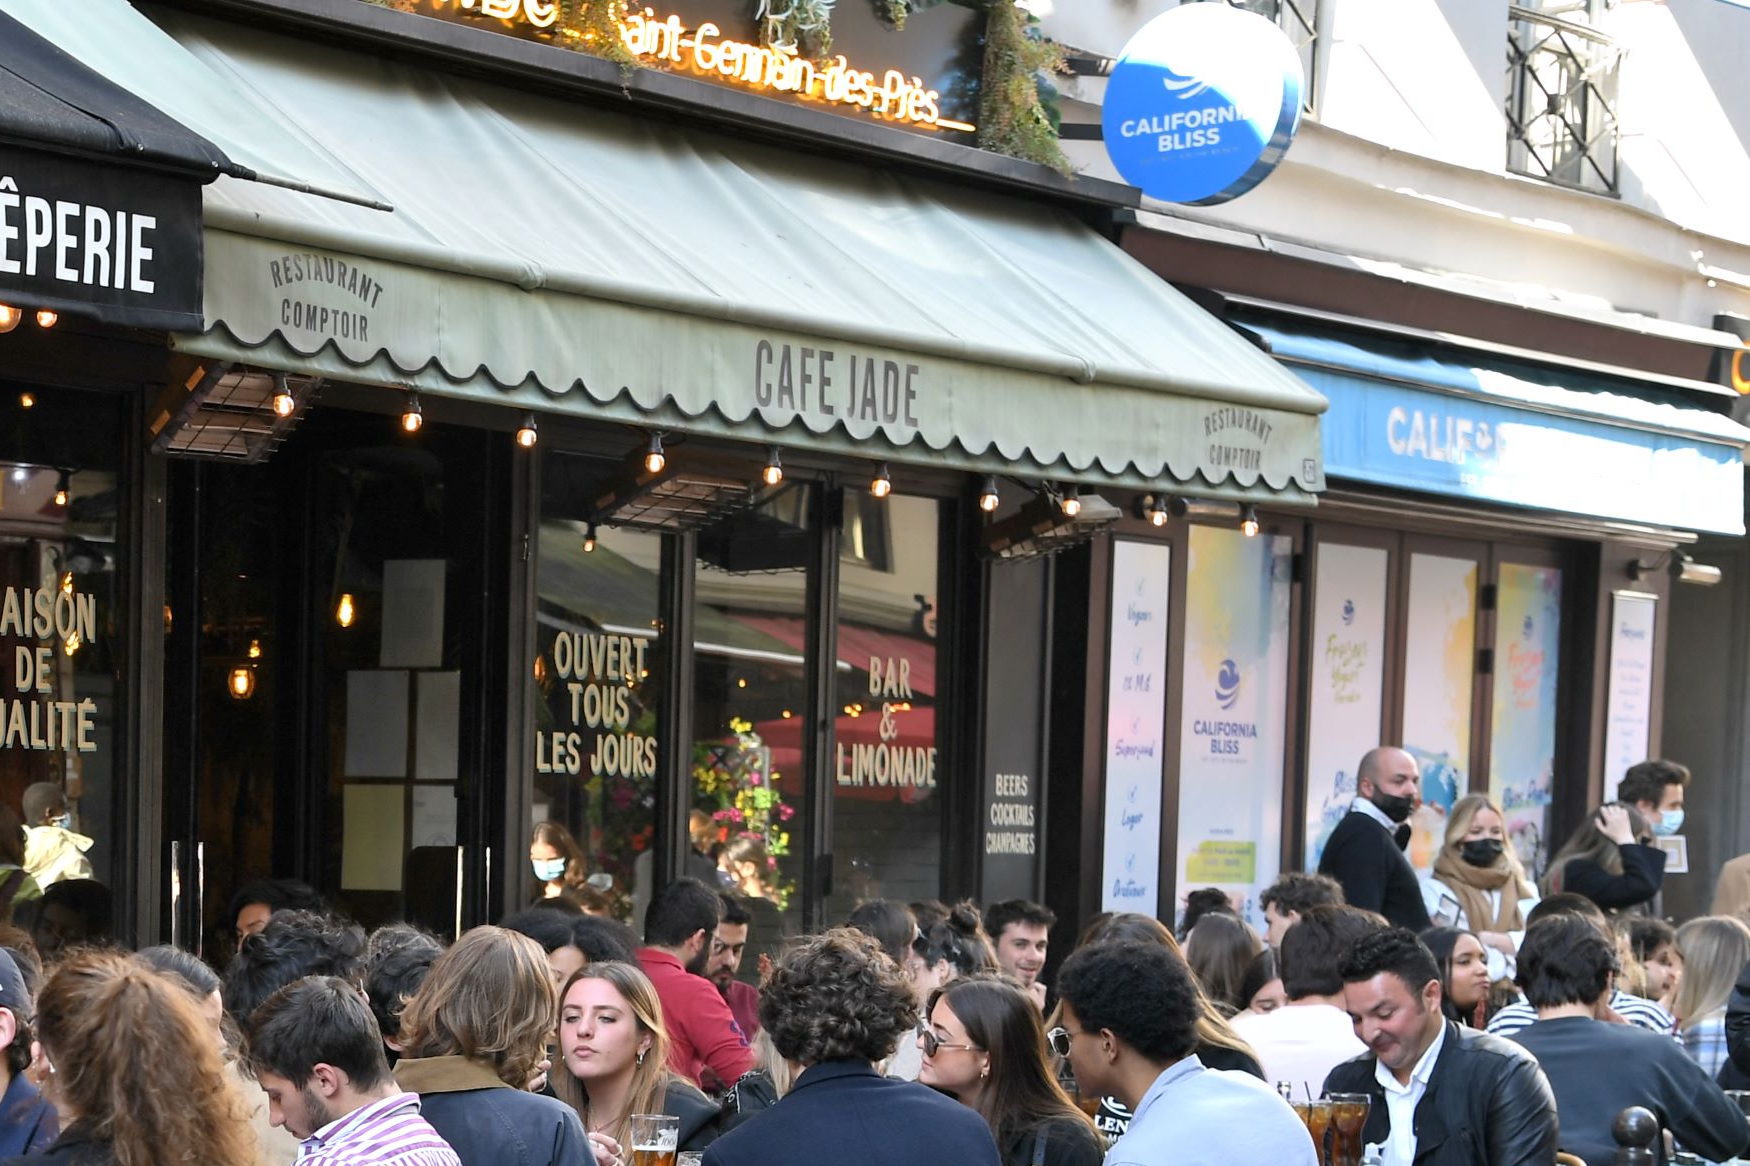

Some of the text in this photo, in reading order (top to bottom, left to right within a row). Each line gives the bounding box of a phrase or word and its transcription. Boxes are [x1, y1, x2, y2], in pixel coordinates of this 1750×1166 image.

[1120, 105, 1252, 138] CALIFORNI
[1158, 128, 1220, 153] BLISS
[270, 253, 384, 310] RESTAURANT
[280, 298, 370, 343] COMPTOIR
[754, 339, 920, 428] CAFE JADE
[1204, 407, 1273, 445] RESTAURANT
[1209, 444, 1262, 471] COMPTOIR
[15, 645, 53, 693] DE
[554, 631, 649, 683] OUVERT
[869, 656, 913, 700] BAR
[568, 682, 630, 729] TOUS
[879, 701, 898, 742] &
[1193, 720, 1257, 739] CALIFORNIA
[1210, 739, 1240, 755] BLISS
[536, 731, 657, 779] LES JOURS
[836, 742, 938, 788] LIMONADE
[994, 773, 1029, 798] BEERS
[990, 802, 1036, 828] COCKTAILS
[985, 831, 1036, 856] CHAMPAGNES
